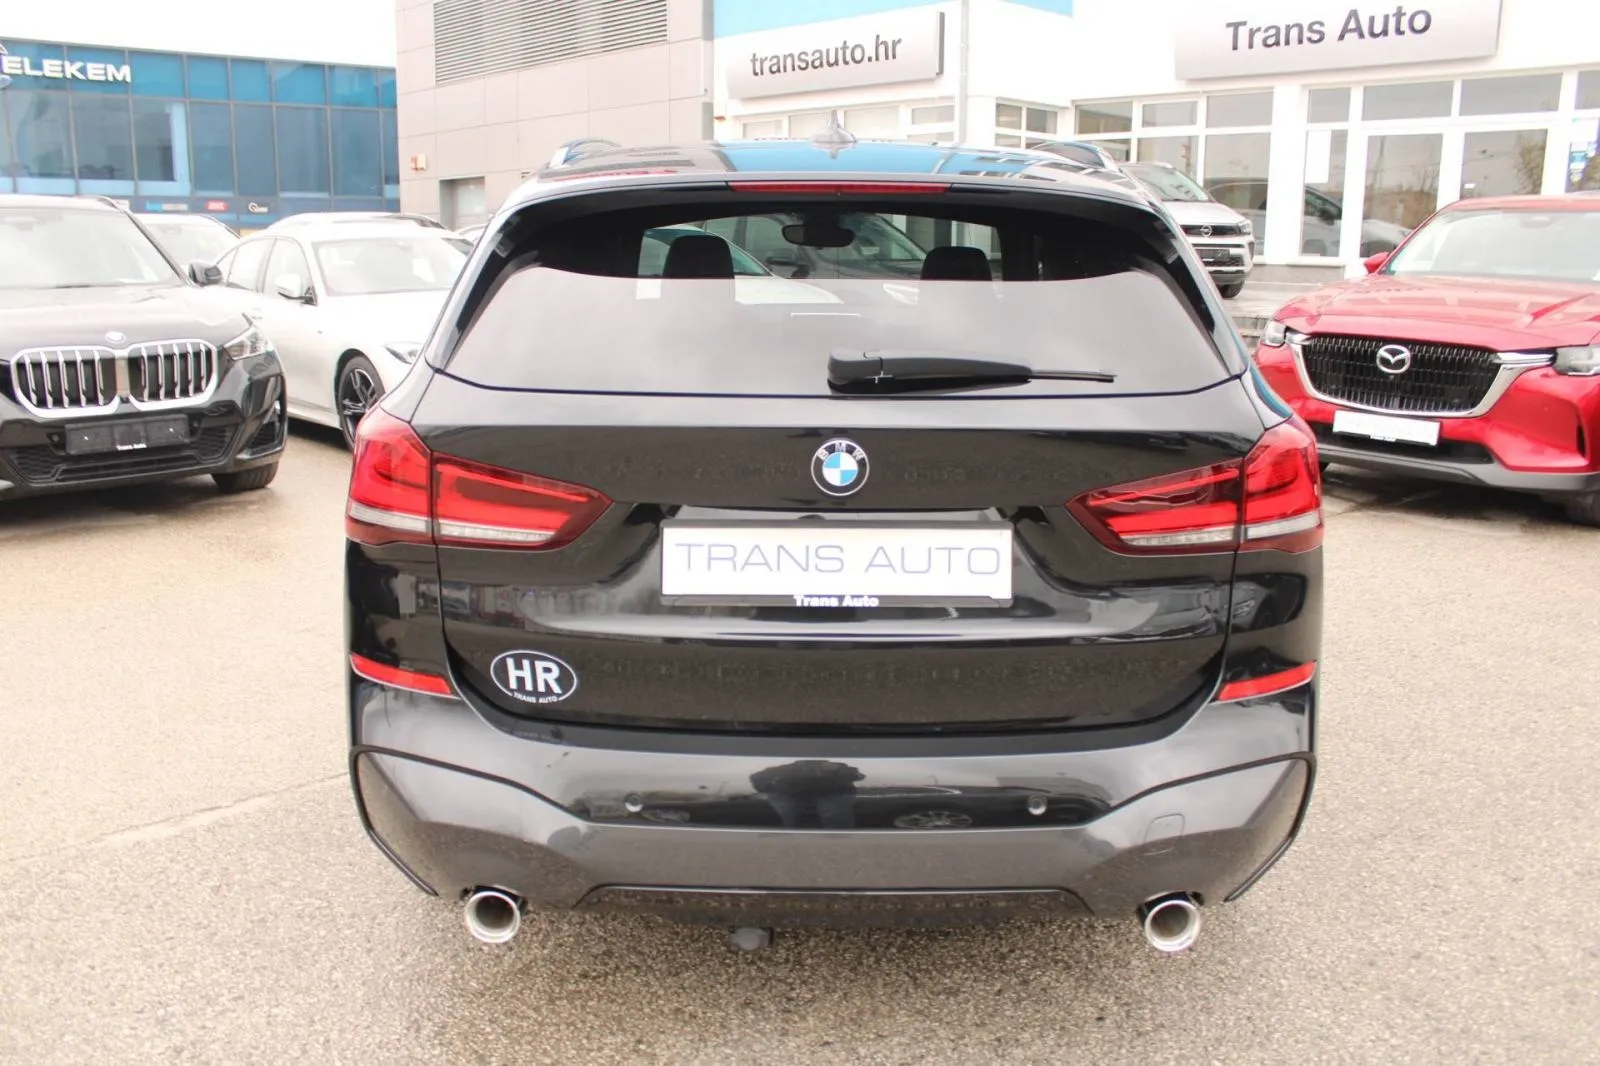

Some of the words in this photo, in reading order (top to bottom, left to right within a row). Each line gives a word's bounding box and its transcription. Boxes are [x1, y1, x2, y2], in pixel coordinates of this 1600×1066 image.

[1225, 20, 1326, 51] Trans
[1337, 5, 1432, 41] Auto
[2, 56, 131, 83] ELEKEM
[750, 35, 902, 76] transauto.hr
[675, 543, 845, 573] TRANS
[864, 545, 1000, 575] AUTO
[793, 595, 839, 607] Trans
[842, 595, 879, 607] Auto
[506, 657, 562, 694] HR
[513, 692, 536, 703] TRANS
